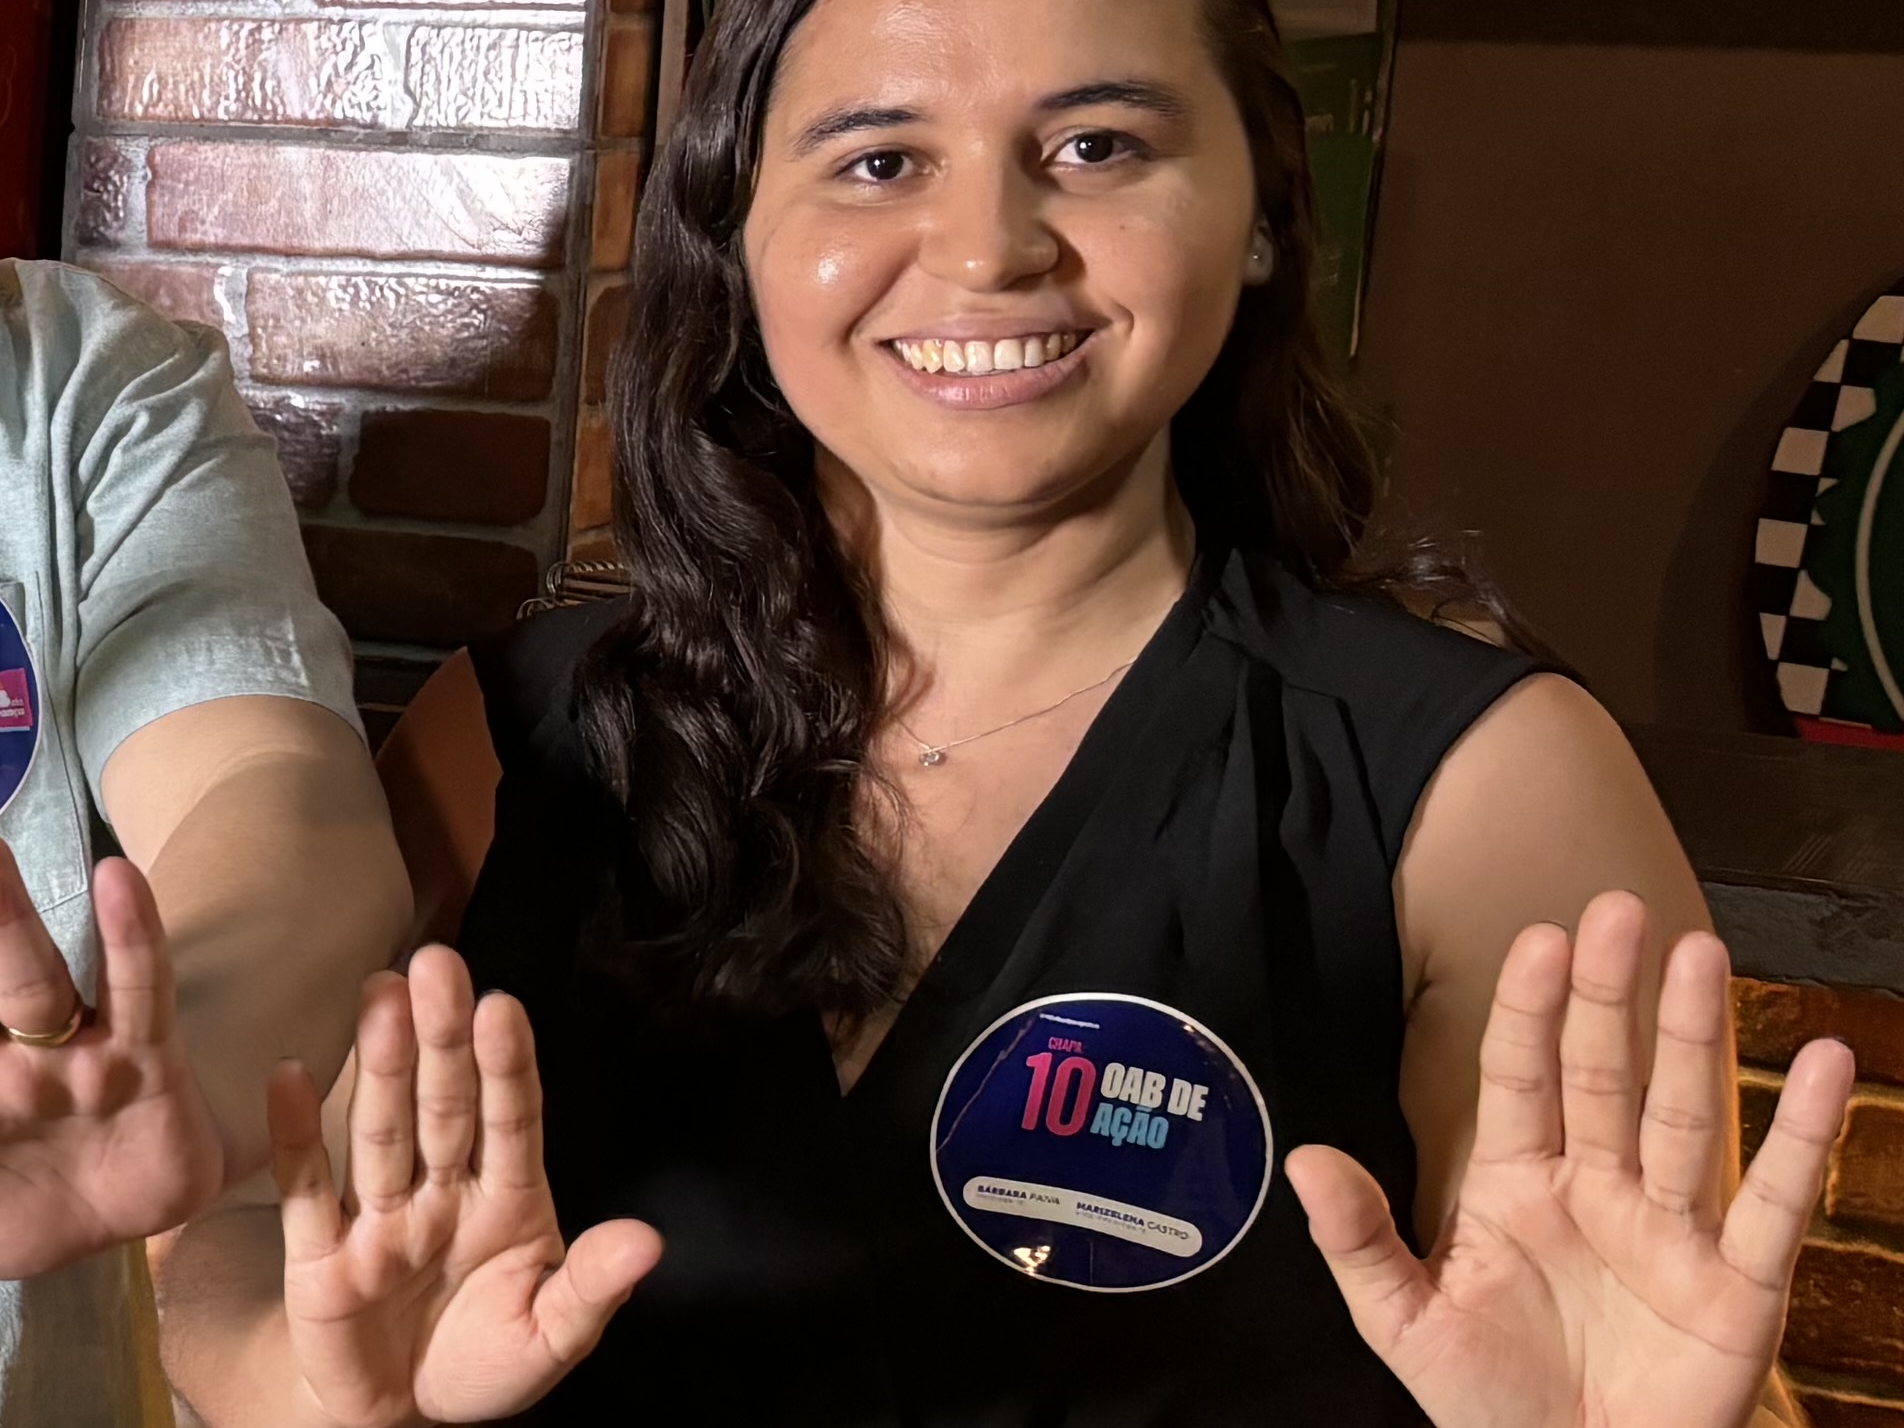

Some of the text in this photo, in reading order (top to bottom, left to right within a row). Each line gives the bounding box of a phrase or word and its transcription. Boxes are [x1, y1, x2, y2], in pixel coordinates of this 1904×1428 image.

[1020, 1051, 1097, 1137] 10
[1099, 1061, 1210, 1122] OAB DE
[1089, 1101, 1170, 1150] AÇÃO
[1146, 1220, 1190, 1241] CASTRO
